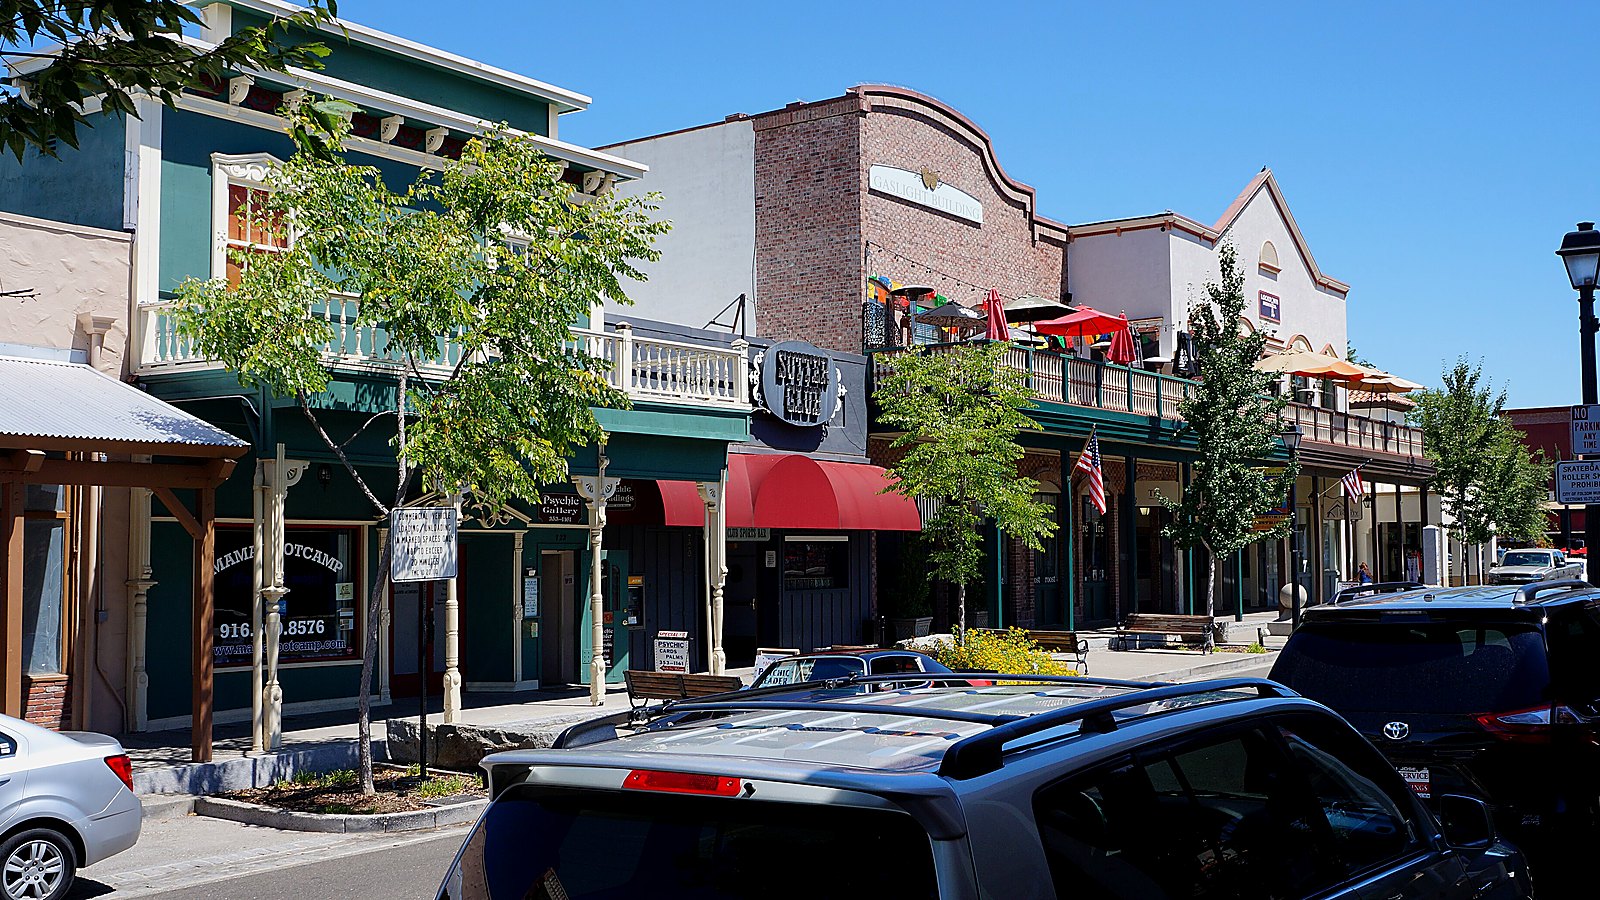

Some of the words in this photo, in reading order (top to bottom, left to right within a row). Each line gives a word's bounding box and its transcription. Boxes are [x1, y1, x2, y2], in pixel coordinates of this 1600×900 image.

[873, 175, 929, 203] GASLIGHT
[931, 193, 980, 220] BUILDING
[1574, 407, 1587, 419] NO
[1574, 421, 1600, 432] PARKIN
[1583, 432, 1597, 440] ANY
[1583, 440, 1598, 449] TIME
[1562, 465, 1600, 473] SKATEBOA
[1562, 473, 1590, 481] ROLLER
[543, 494, 580, 507] Psychic
[542, 506, 579, 516] Gallery
[422, 534, 441, 543] SPACES
[283, 542, 344, 573] OTCAMP
[658, 641, 685, 649] PSYCHIC
[758, 667, 790, 677] PCHIC
